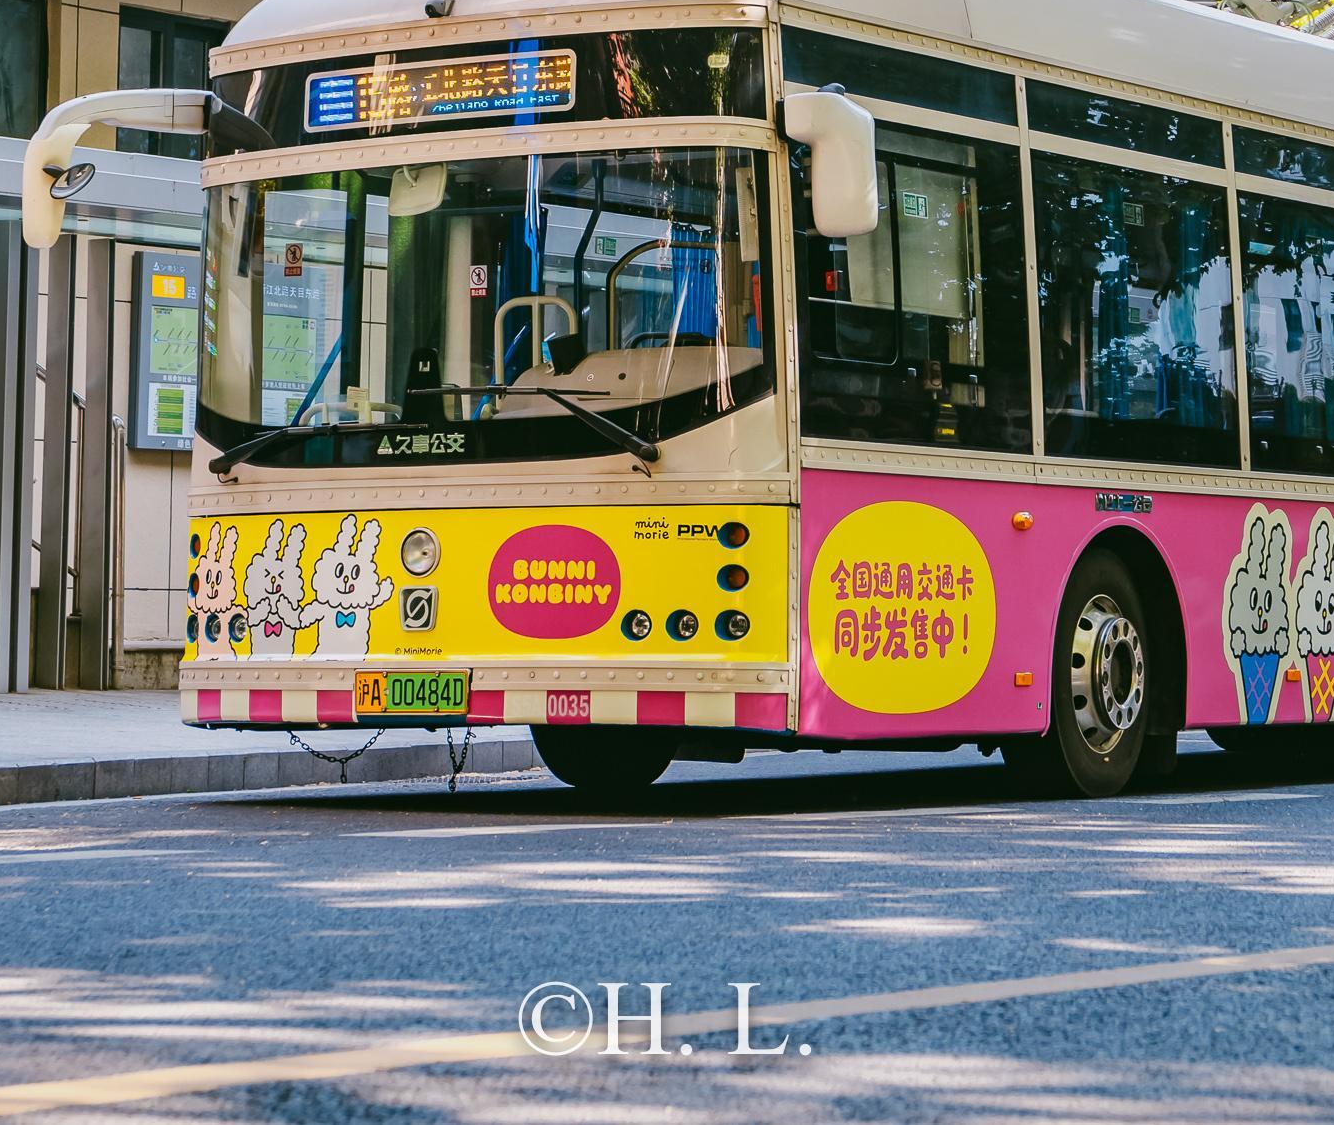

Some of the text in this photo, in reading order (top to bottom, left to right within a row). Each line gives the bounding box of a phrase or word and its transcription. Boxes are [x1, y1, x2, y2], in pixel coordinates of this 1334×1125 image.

[162, 279, 177, 295] 15
[394, 432, 466, 455] 久事公交
[634, 516, 670, 529] mini
[677, 524, 720, 538] PPW
[634, 529, 670, 540] morie
[512, 558, 596, 581] BUNNI
[830, 559, 975, 601] 全国通用交通卡
[495, 582, 612, 605] KONBINY
[834, 605, 969, 662] 同步发售中！
[403, 646, 443, 656] MiniMorie
[547, 694, 591, 718] 0035
